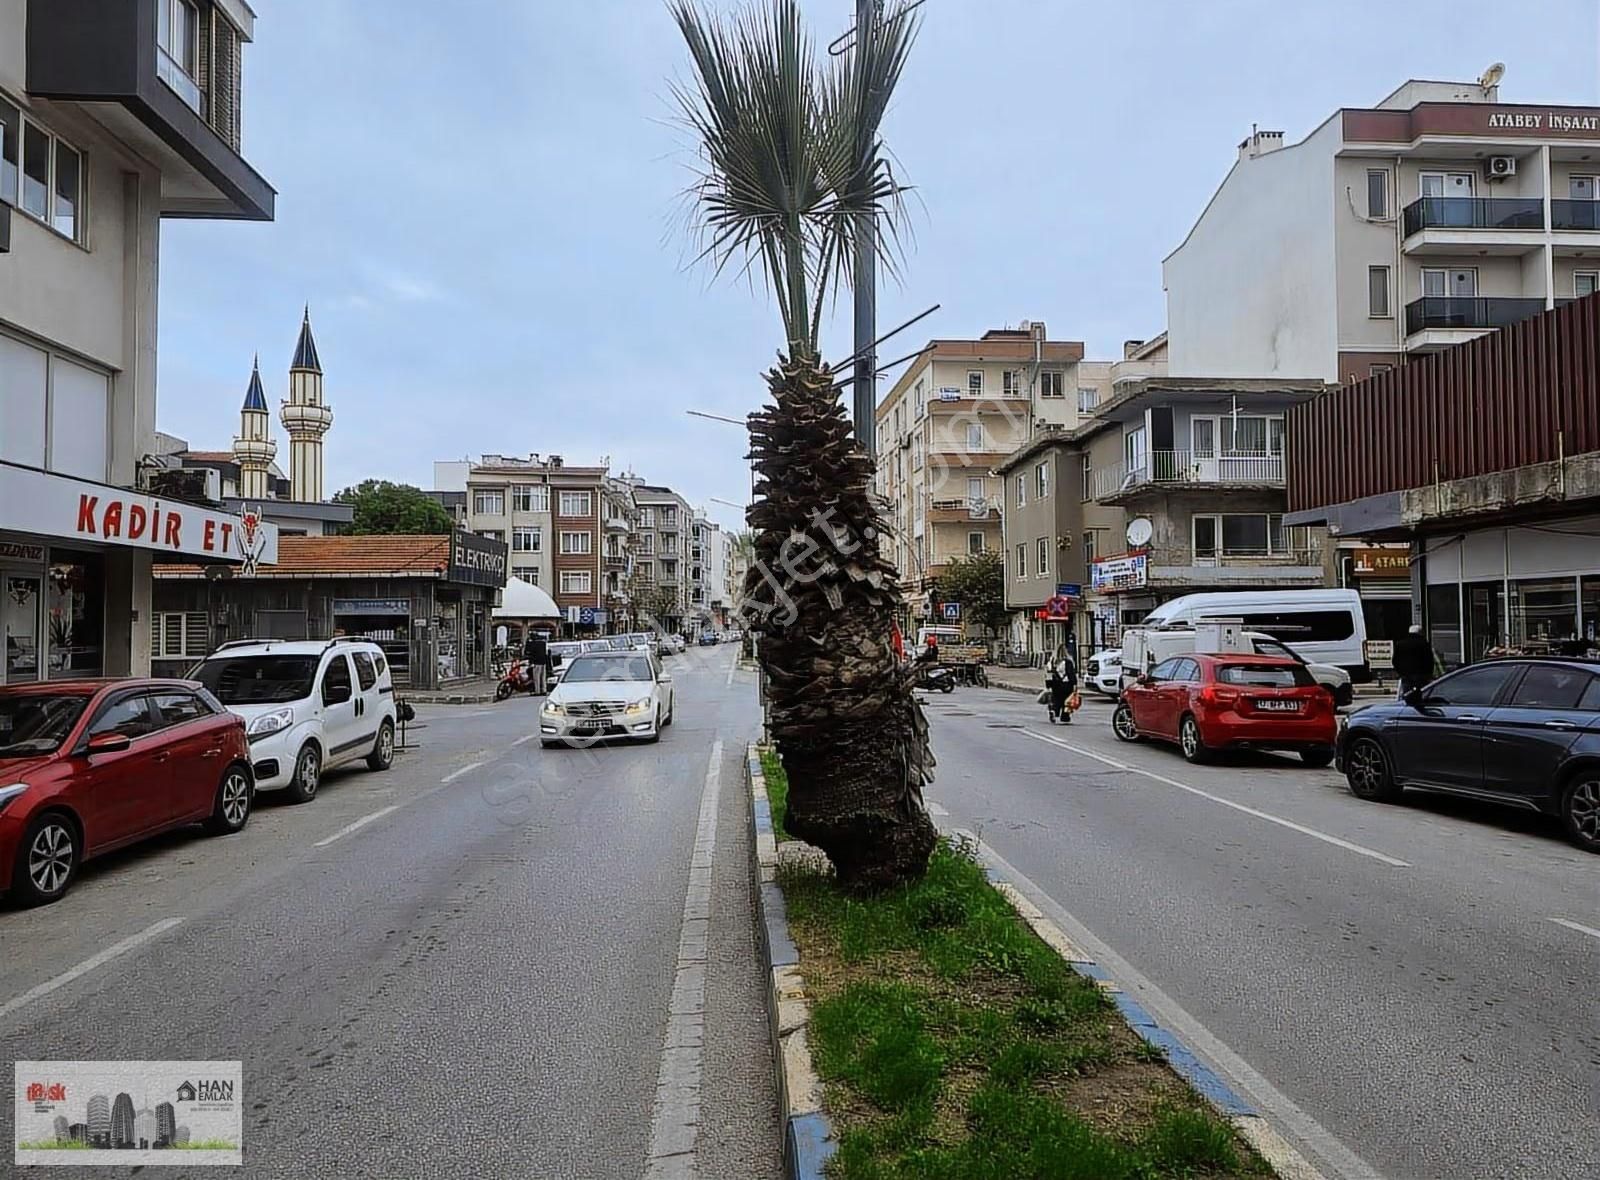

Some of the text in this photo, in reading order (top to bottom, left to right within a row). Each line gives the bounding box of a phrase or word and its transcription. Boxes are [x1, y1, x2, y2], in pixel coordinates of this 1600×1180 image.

[1488, 112, 1599, 132] ATABEY İNŞAAT
[77, 493, 233, 553] KADİR ET
